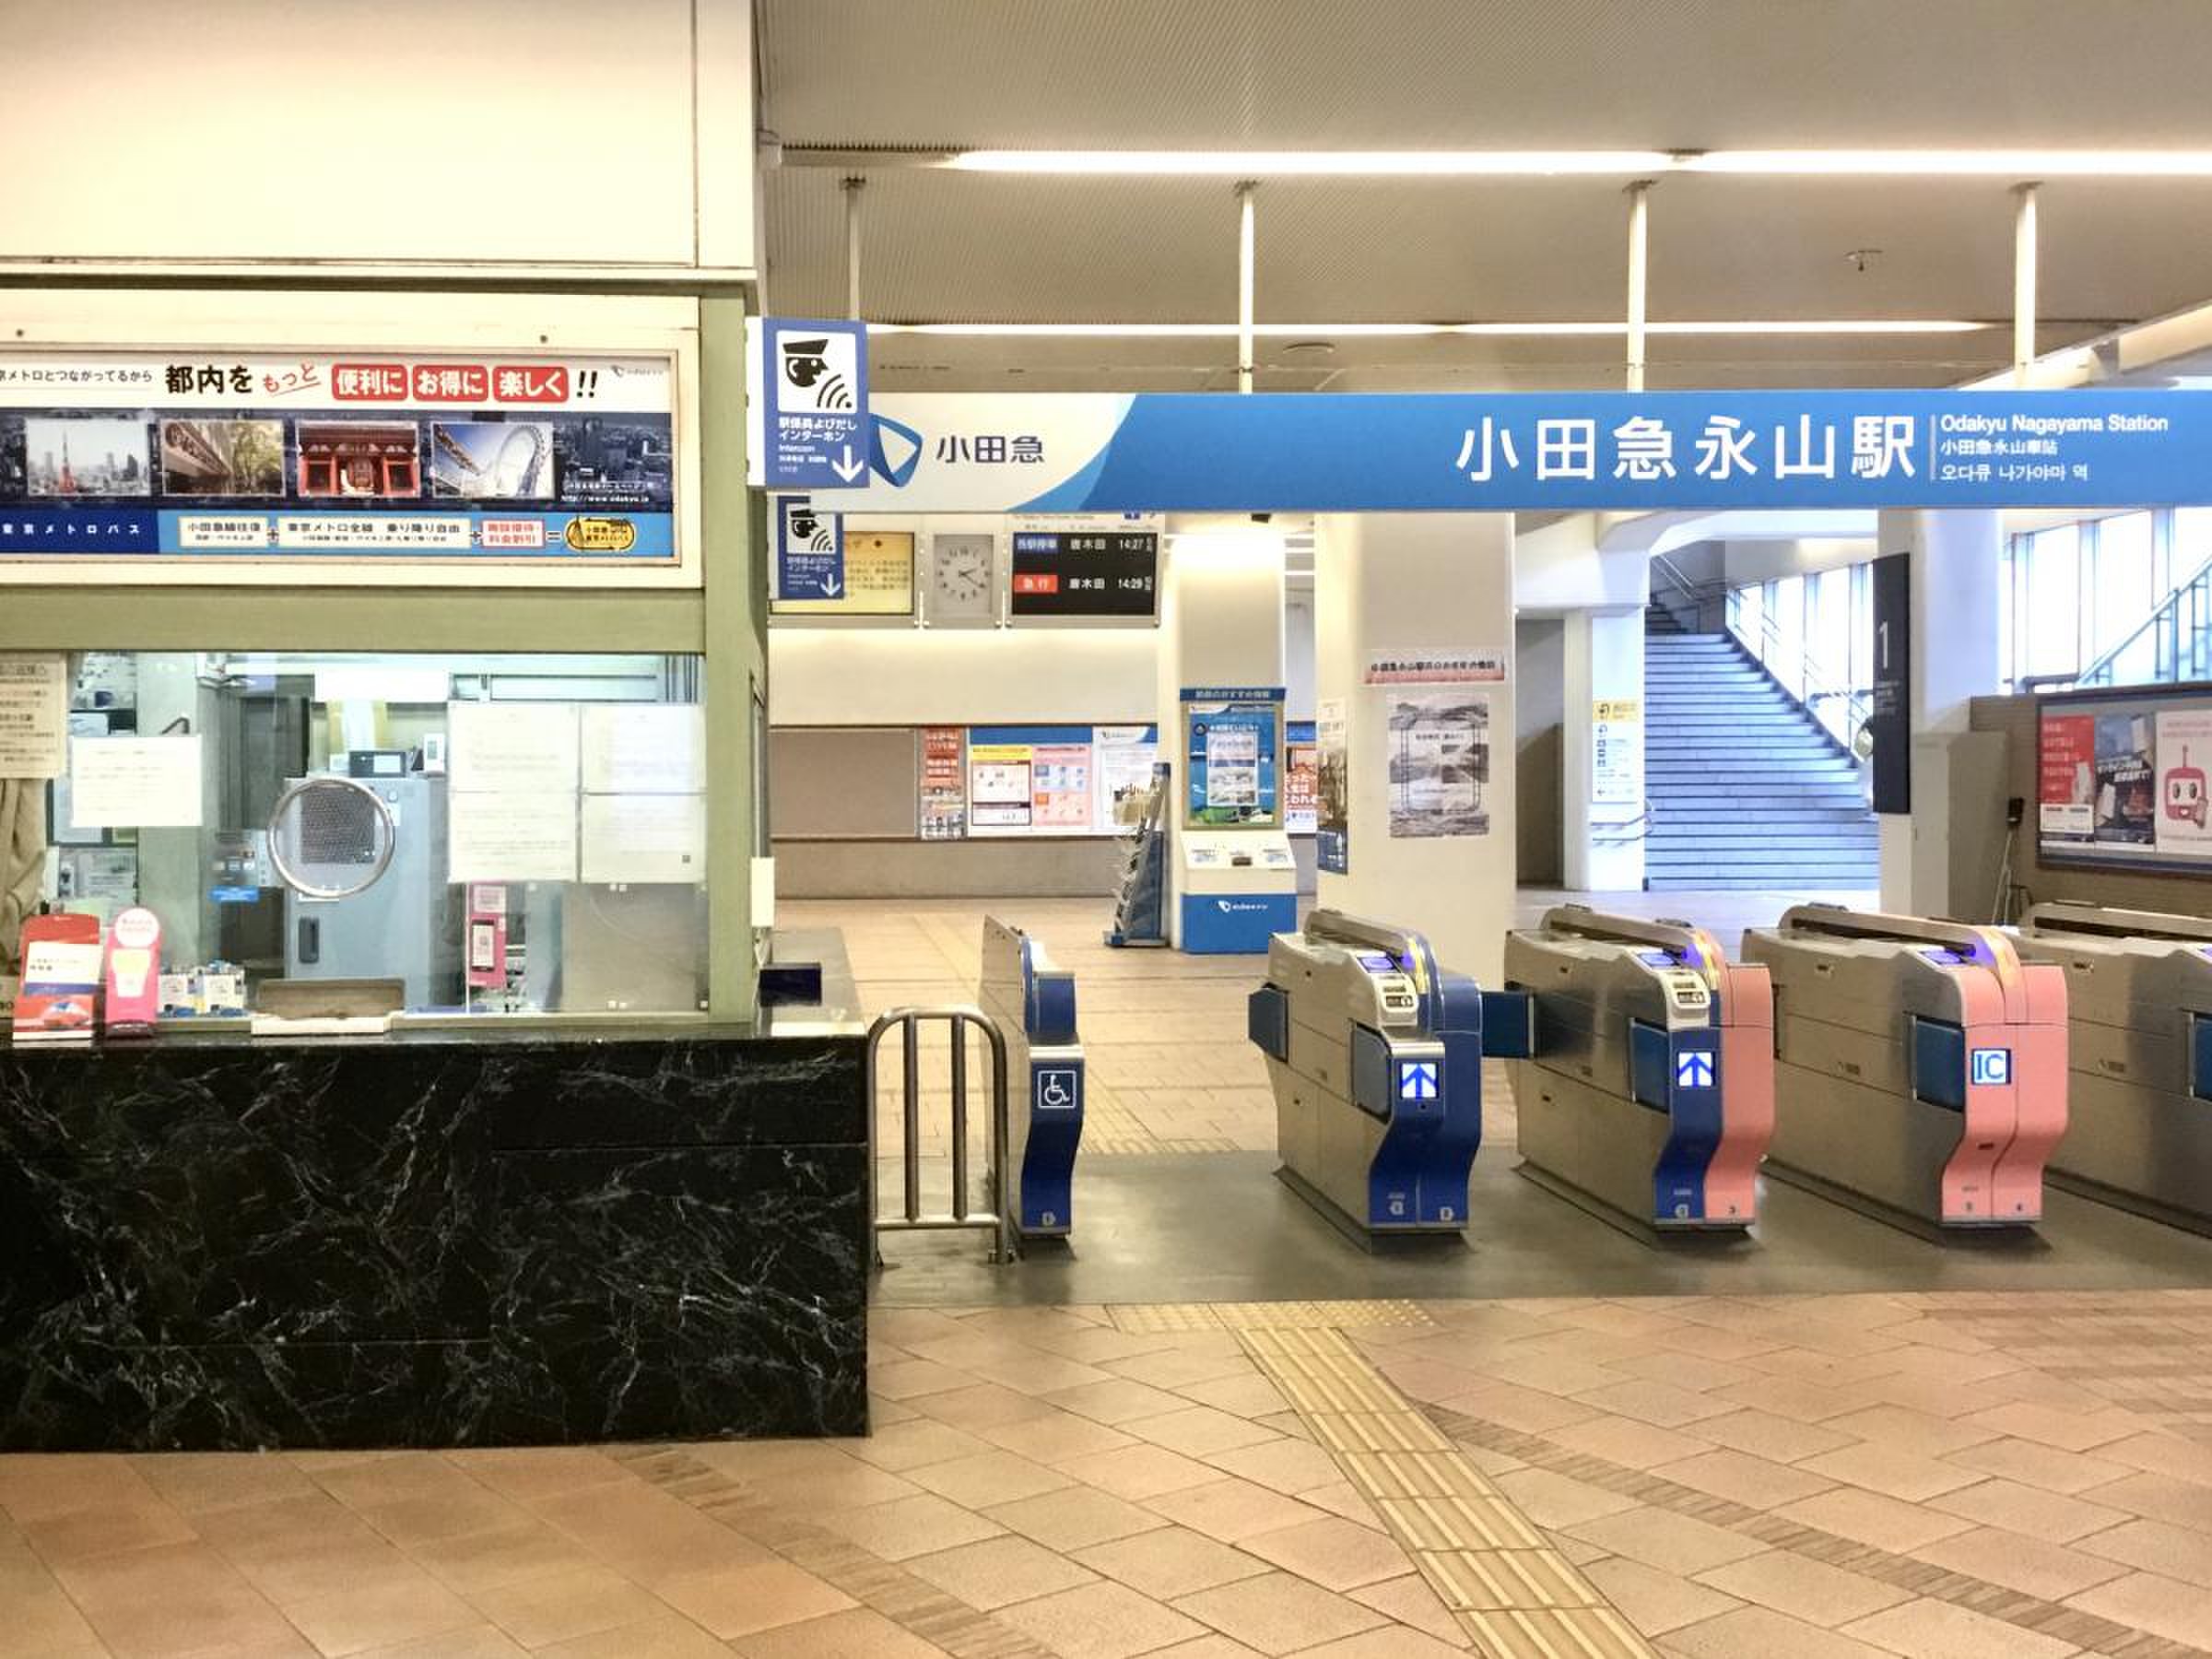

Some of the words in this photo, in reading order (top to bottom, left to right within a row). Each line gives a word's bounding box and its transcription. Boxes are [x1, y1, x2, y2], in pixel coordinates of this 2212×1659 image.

[165, 365, 253, 394] 都内を
[263, 363, 319, 394] もっと
[337, 371, 404, 394] 便利に
[418, 371, 484, 395] お得に
[499, 371, 563, 395] 楽しく
[778, 430, 845, 442] インターホン
[1940, 415, 2006, 435] Odakyu
[2012, 415, 2103, 435] Nagayama
[2108, 415, 2169, 431] Station
[935, 434, 1044, 464] 小田急
[1455, 414, 1916, 481] 小田急永山駅
[1941, 465, 1991, 480] 오다큐
[2073, 465, 2088, 480] 역
[2, 523, 141, 535] 東京メトロパス
[1878, 620, 1889, 669] 1
[1976, 1053, 2005, 1080] IC
